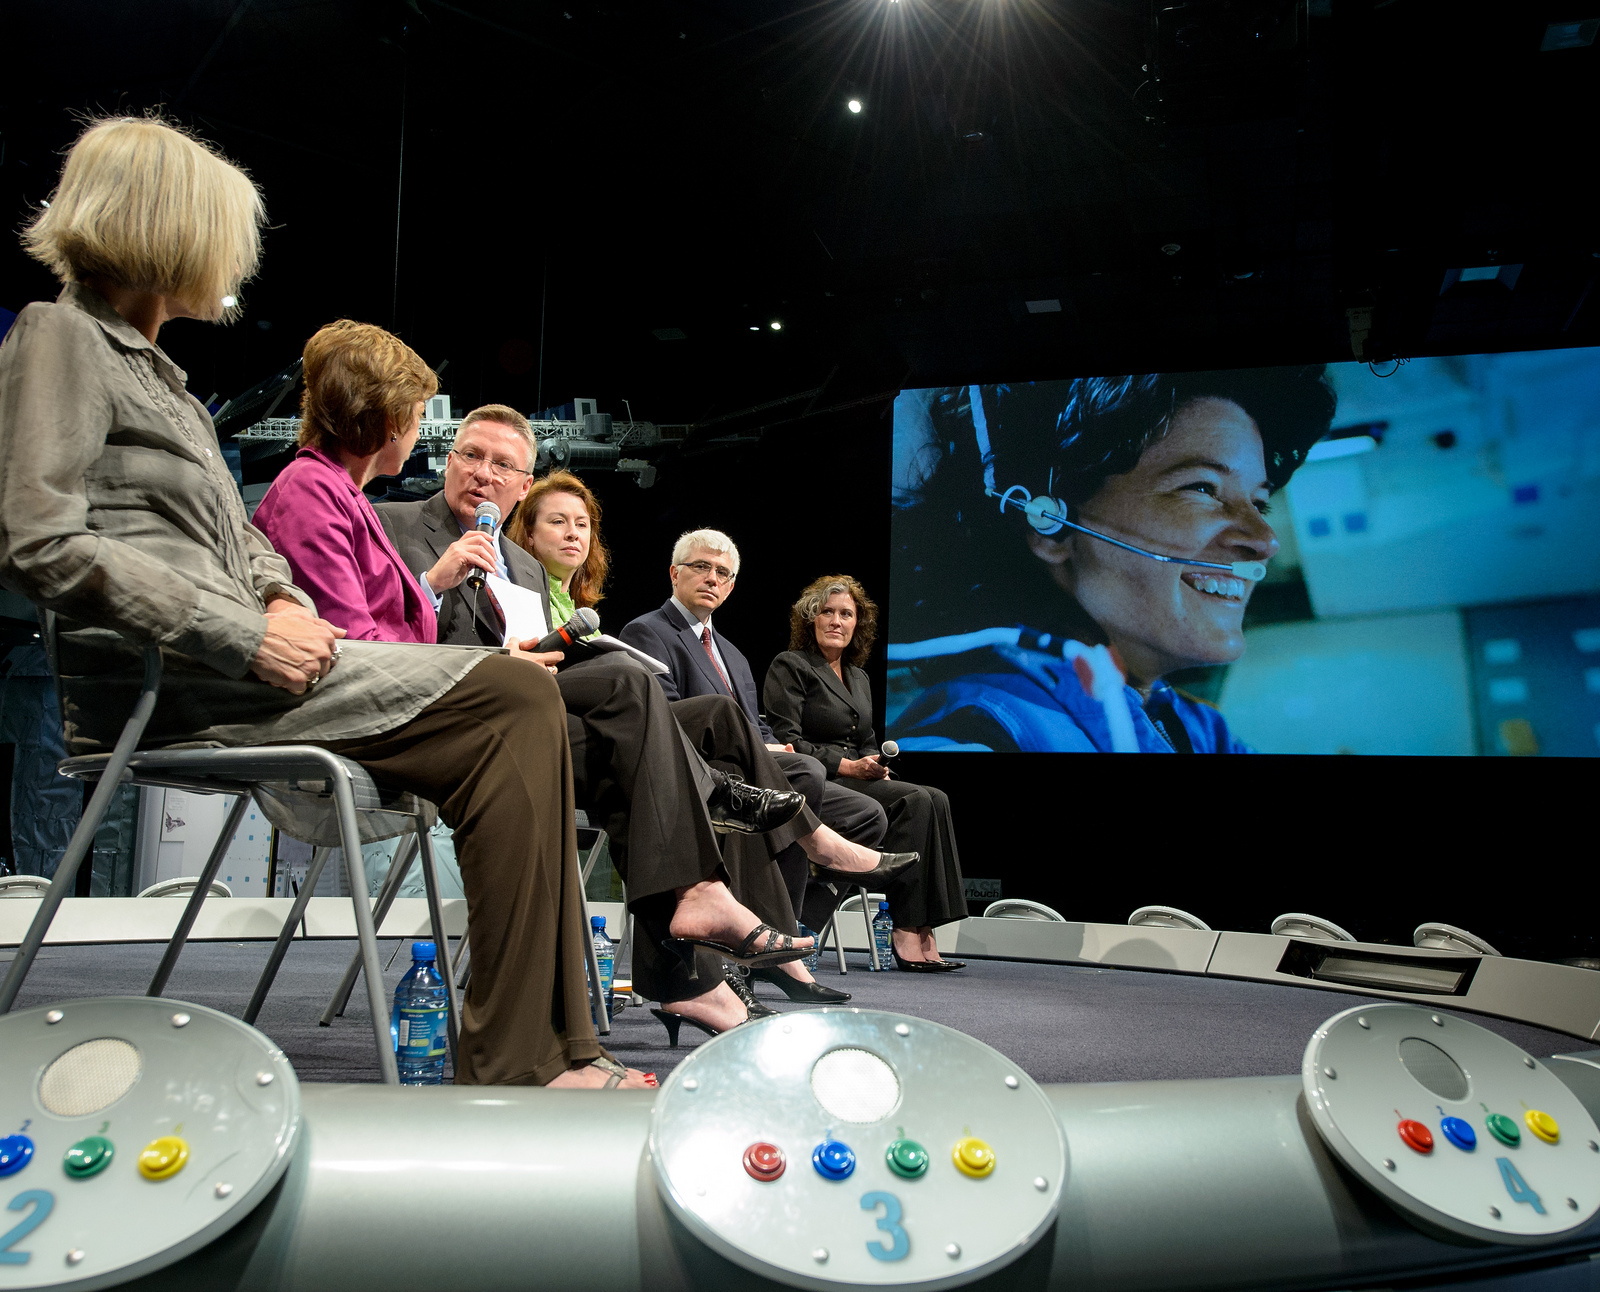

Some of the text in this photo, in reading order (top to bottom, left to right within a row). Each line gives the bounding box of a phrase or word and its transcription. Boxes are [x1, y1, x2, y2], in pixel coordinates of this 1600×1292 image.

[970, 889, 999, 898] Touch
[20, 1119, 32, 1132] 2
[1495, 1157, 1548, 1215] 4
[0, 1189, 55, 1265] 2
[860, 1190, 912, 1262] 3
